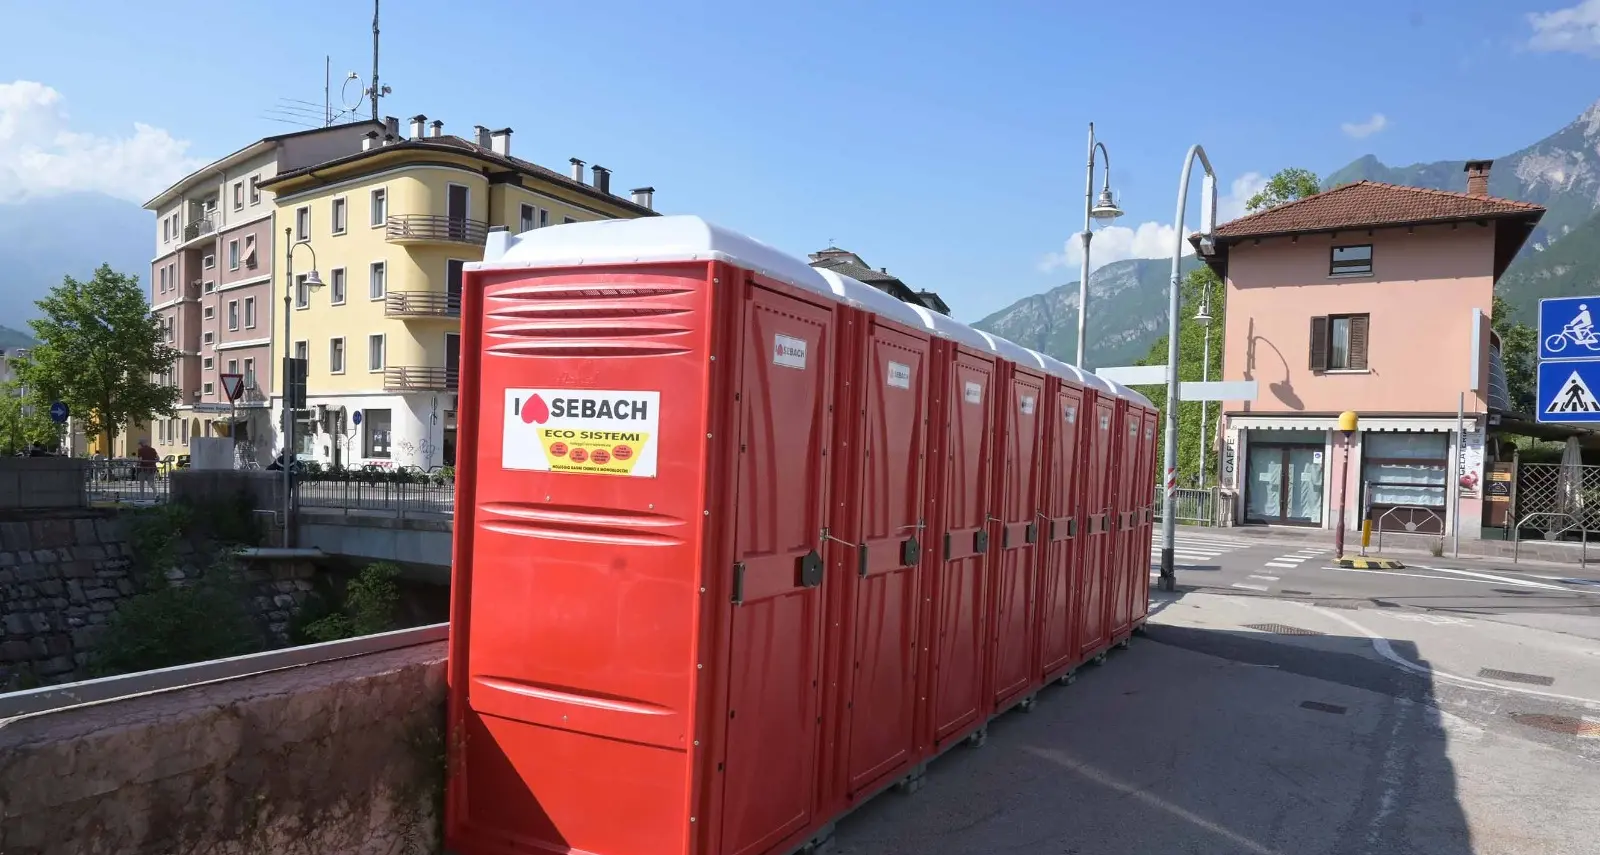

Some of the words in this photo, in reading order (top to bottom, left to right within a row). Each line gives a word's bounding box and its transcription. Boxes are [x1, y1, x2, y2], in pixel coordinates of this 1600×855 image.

[784, 347, 804, 358] SEBACH
[514, 397, 520, 416] I
[551, 397, 648, 420] SEBACH
[544, 429, 575, 439] ECO
[580, 431, 640, 441] SISTEMI
